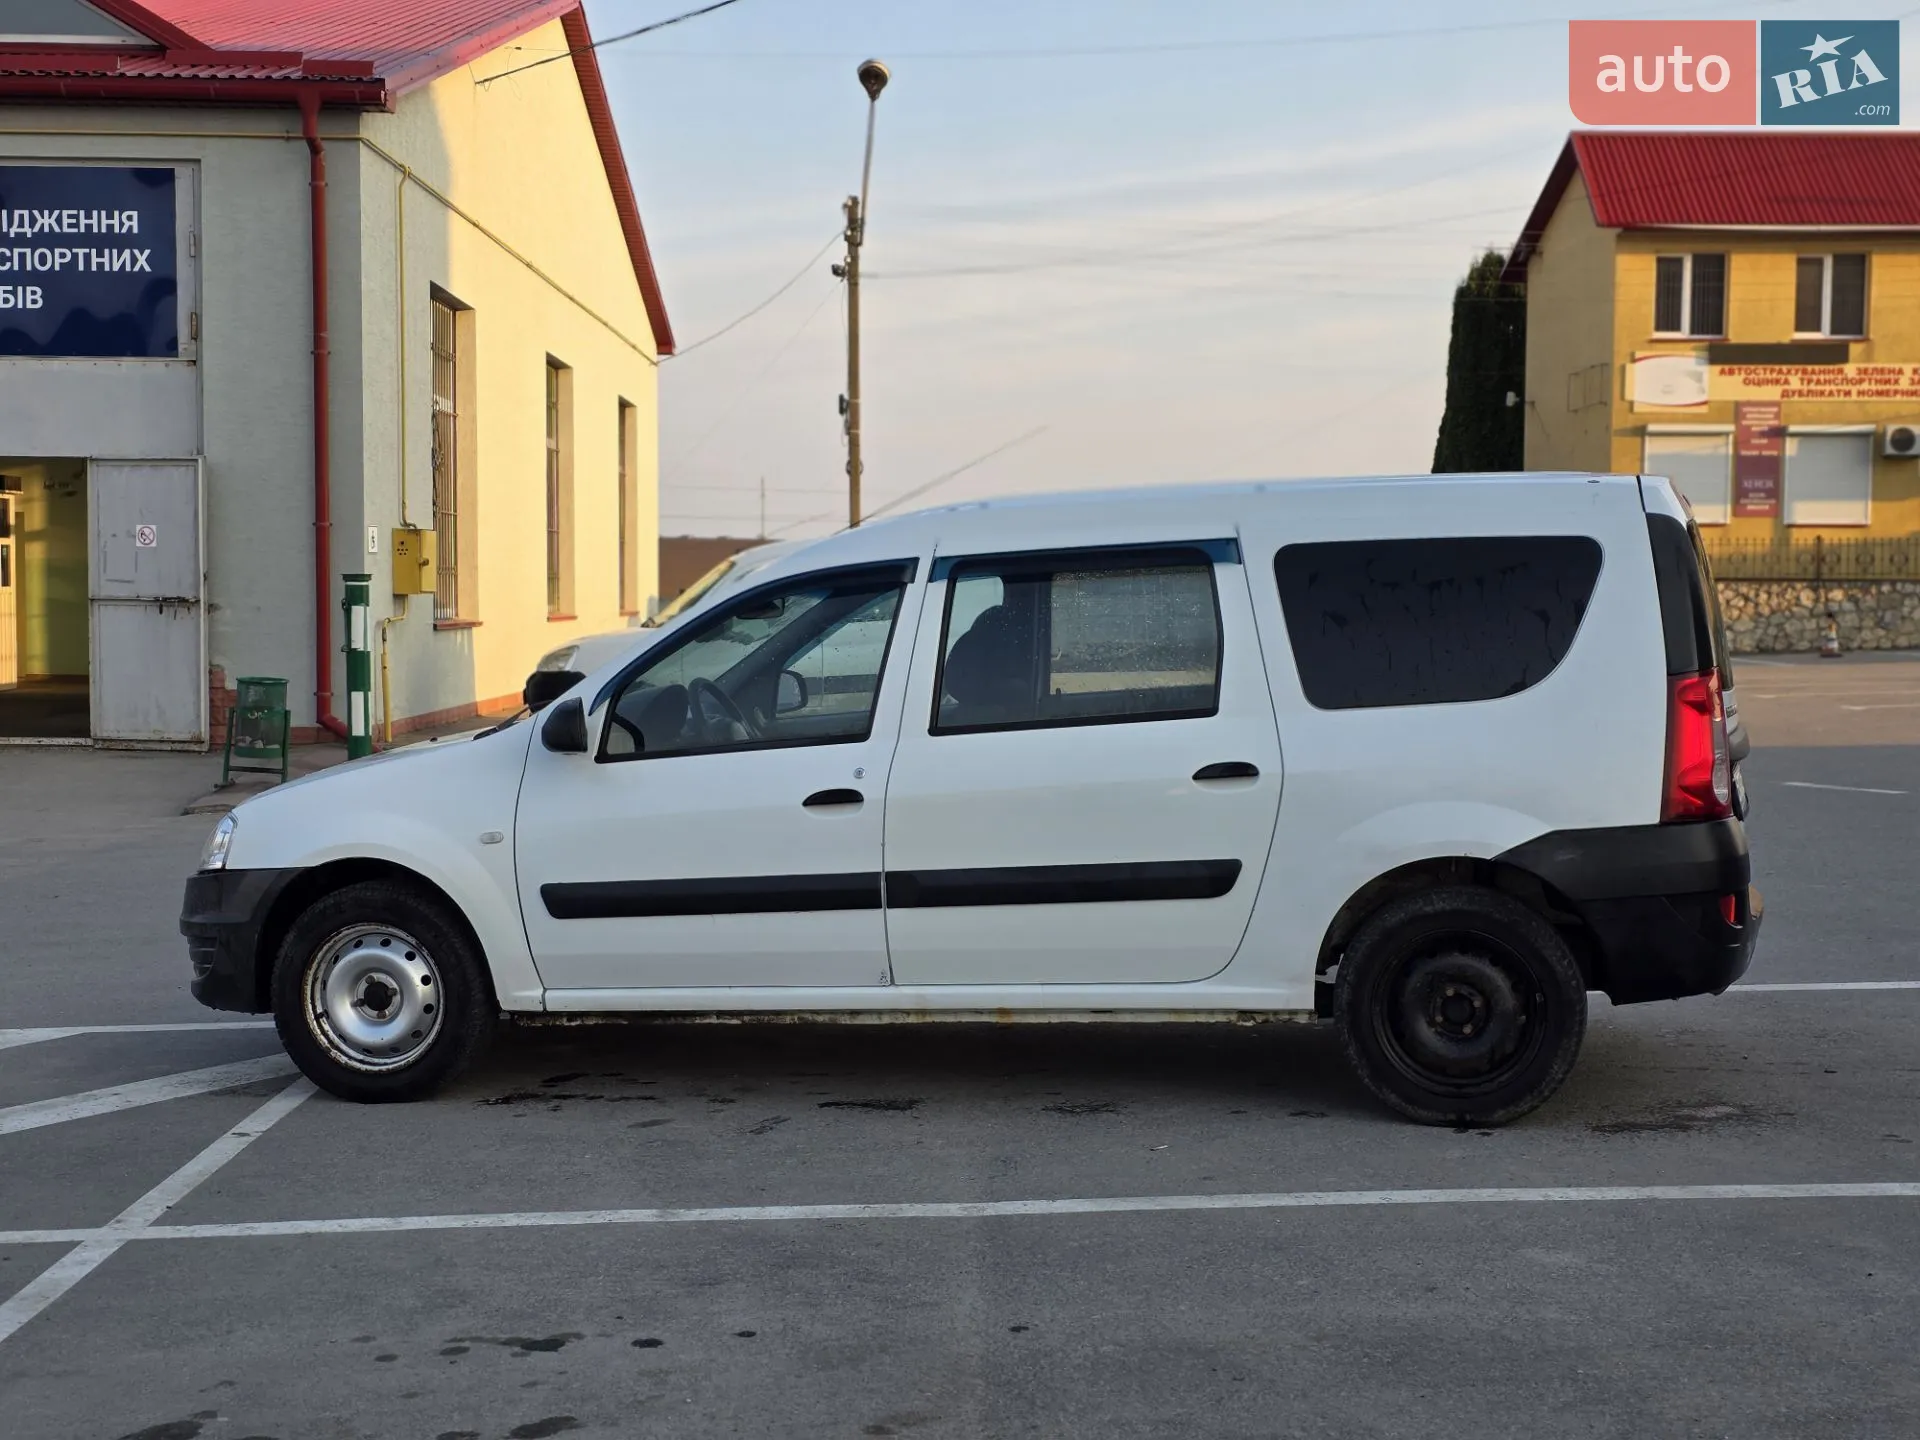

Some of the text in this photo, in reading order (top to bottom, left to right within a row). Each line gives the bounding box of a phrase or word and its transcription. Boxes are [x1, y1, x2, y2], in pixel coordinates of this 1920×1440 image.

[2, 209, 139, 238] ІДЖЕННЯ
[0, 248, 152, 272] СПОРТНИХ
[0, 285, 43, 309] БІВ
[1856, 367, 1904, 376] ЗЕЛЕНА
[1743, 377, 1791, 387] ОЦІНКА
[1799, 377, 1900, 386] ТРАНСПОРТНИХ
[1780, 389, 1920, 399] ДУБЛІКАТИ НОМЕРНИ
